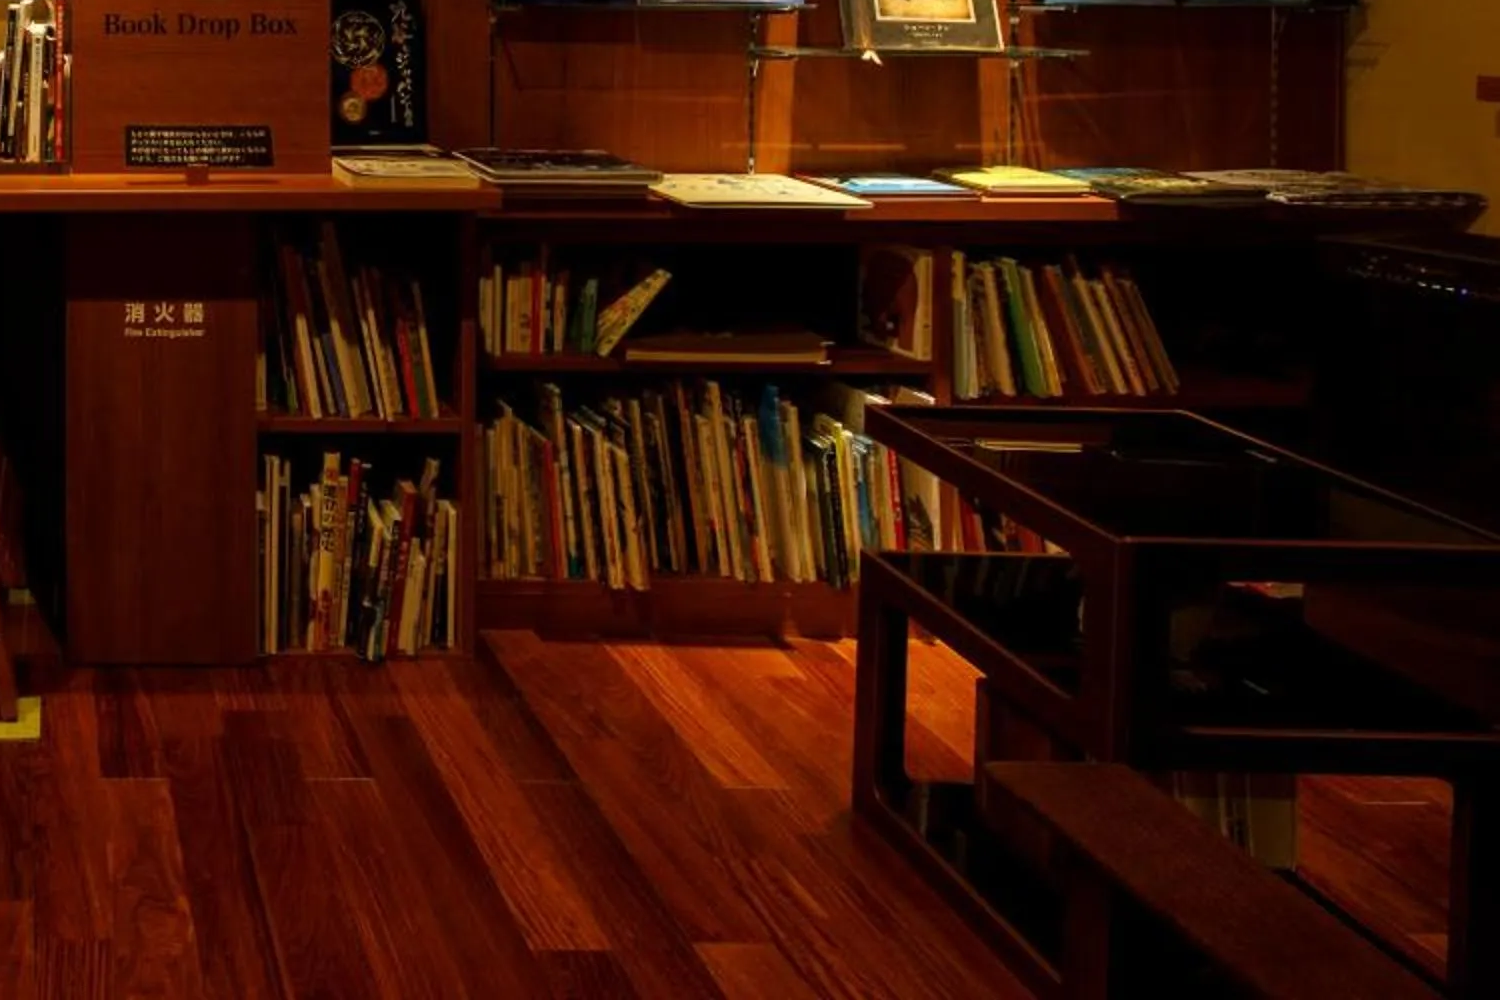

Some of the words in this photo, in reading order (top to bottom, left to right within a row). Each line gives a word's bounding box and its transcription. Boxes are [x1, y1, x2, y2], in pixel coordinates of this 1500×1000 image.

[104, 13, 167, 34] Book
[178, 13, 240, 40] Drop
[250, 13, 298, 34] Box
[124, 301, 204, 324] 消火器
